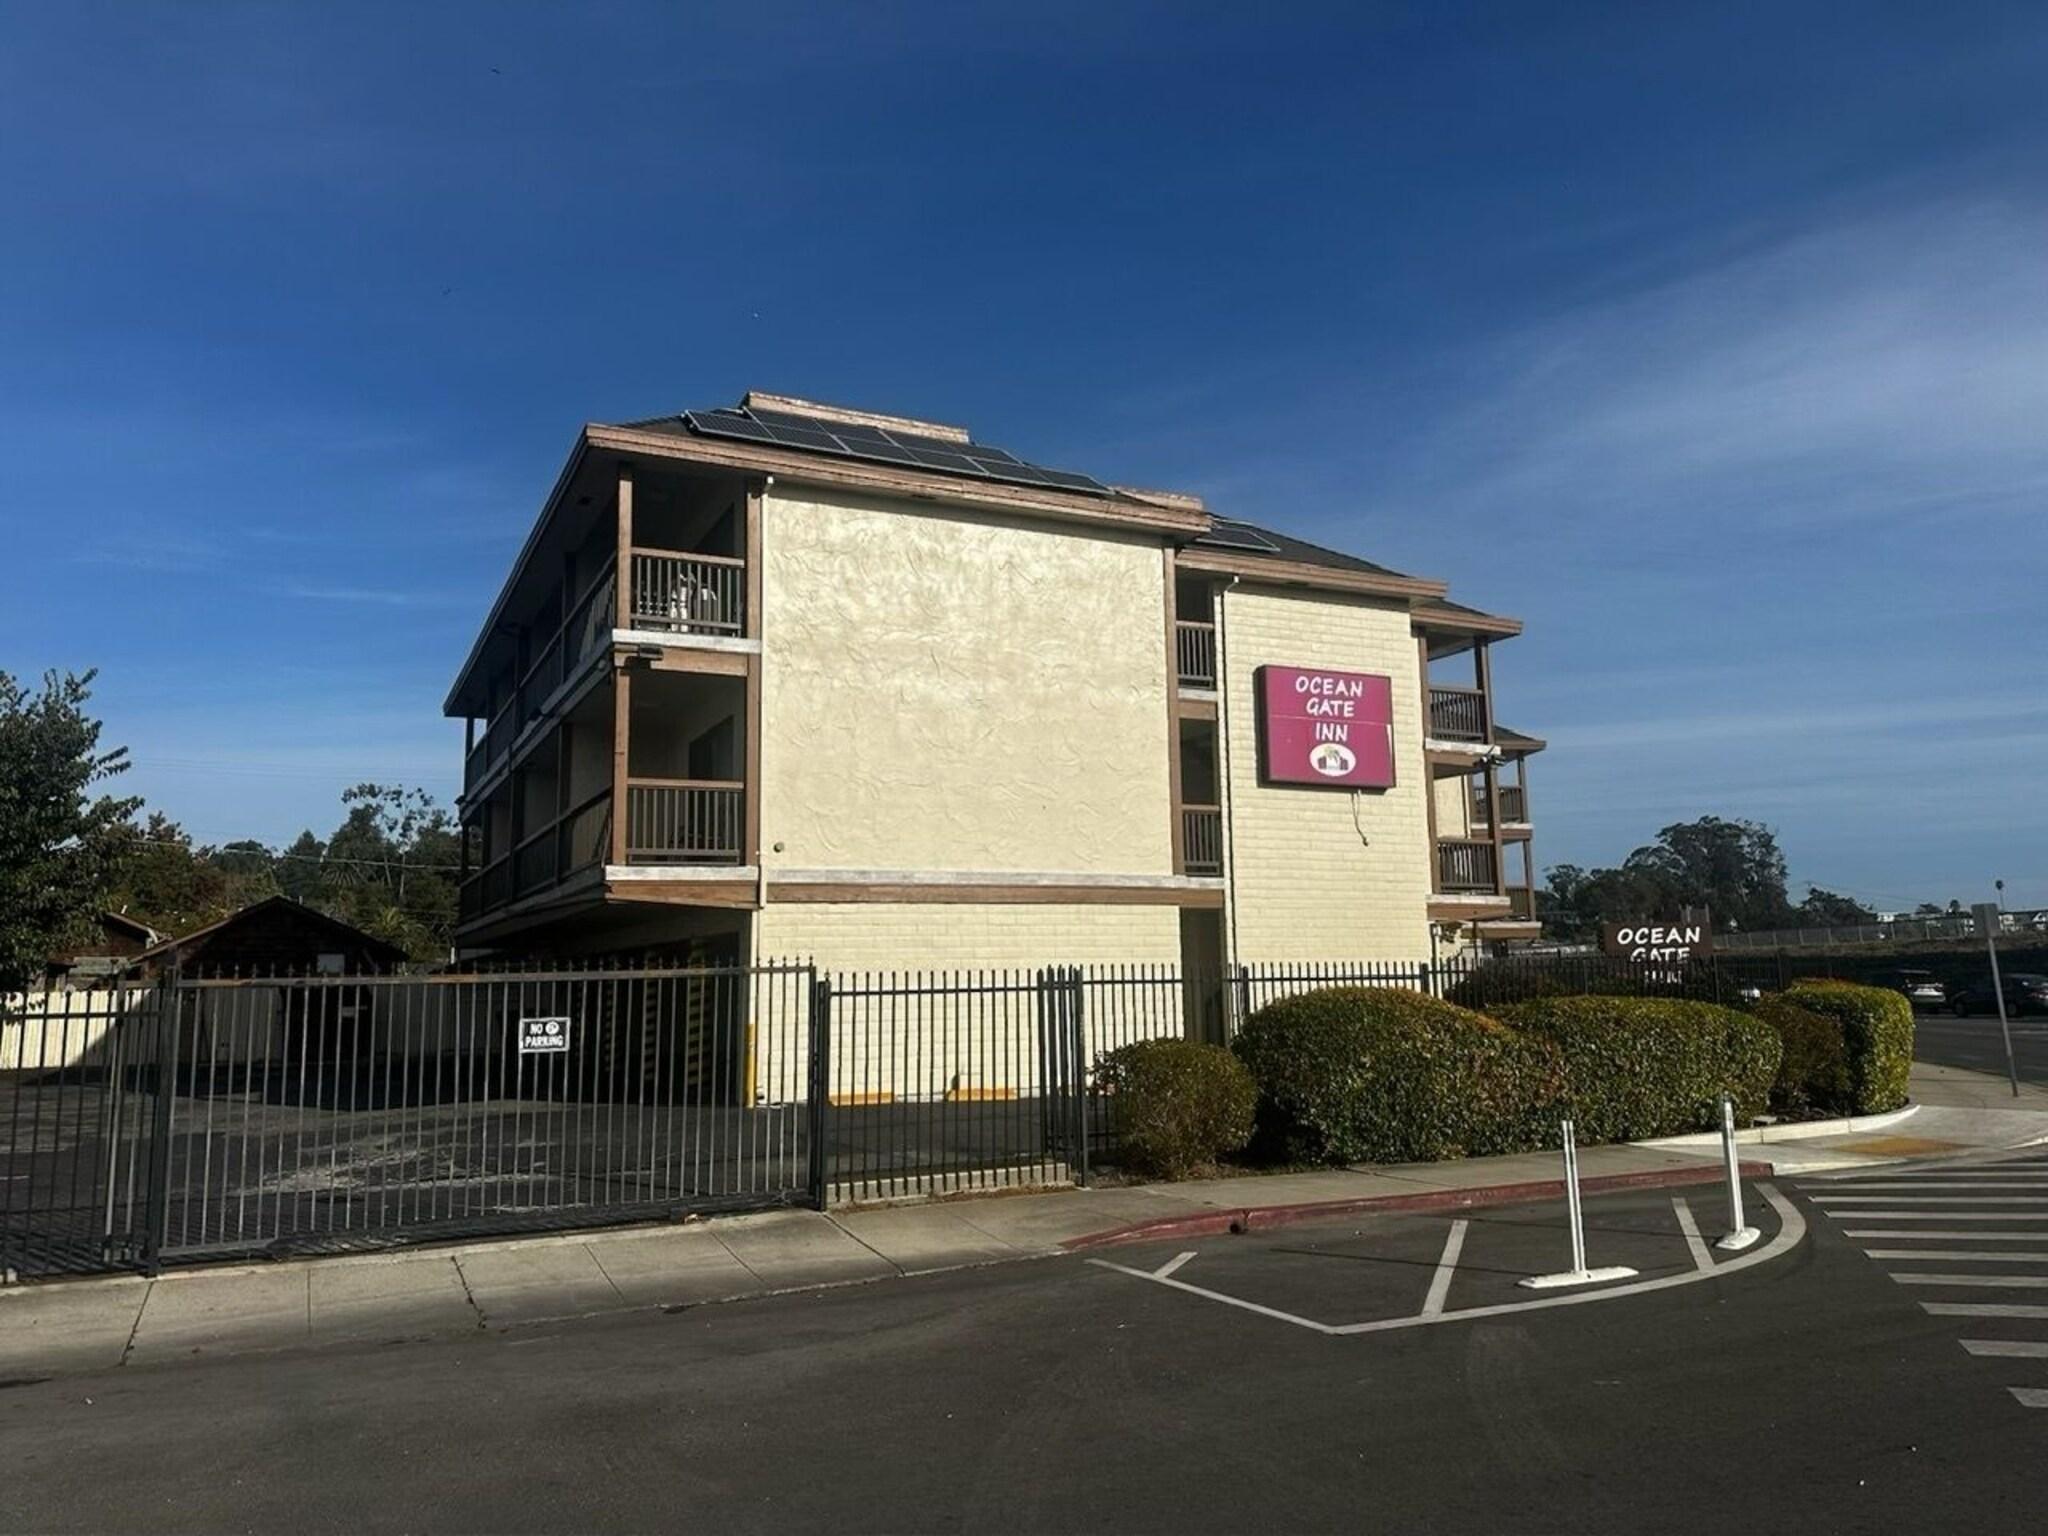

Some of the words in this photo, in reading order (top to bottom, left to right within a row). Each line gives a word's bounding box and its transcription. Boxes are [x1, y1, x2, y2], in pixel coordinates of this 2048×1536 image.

[1295, 676, 1362, 697] OCEAN
[1306, 698, 1354, 717] GATE
[1316, 722, 1347, 742] INN
[1617, 926, 1700, 944] OCEAN
[530, 1024, 543, 1035] NO
[525, 1035, 563, 1047] PARKING
